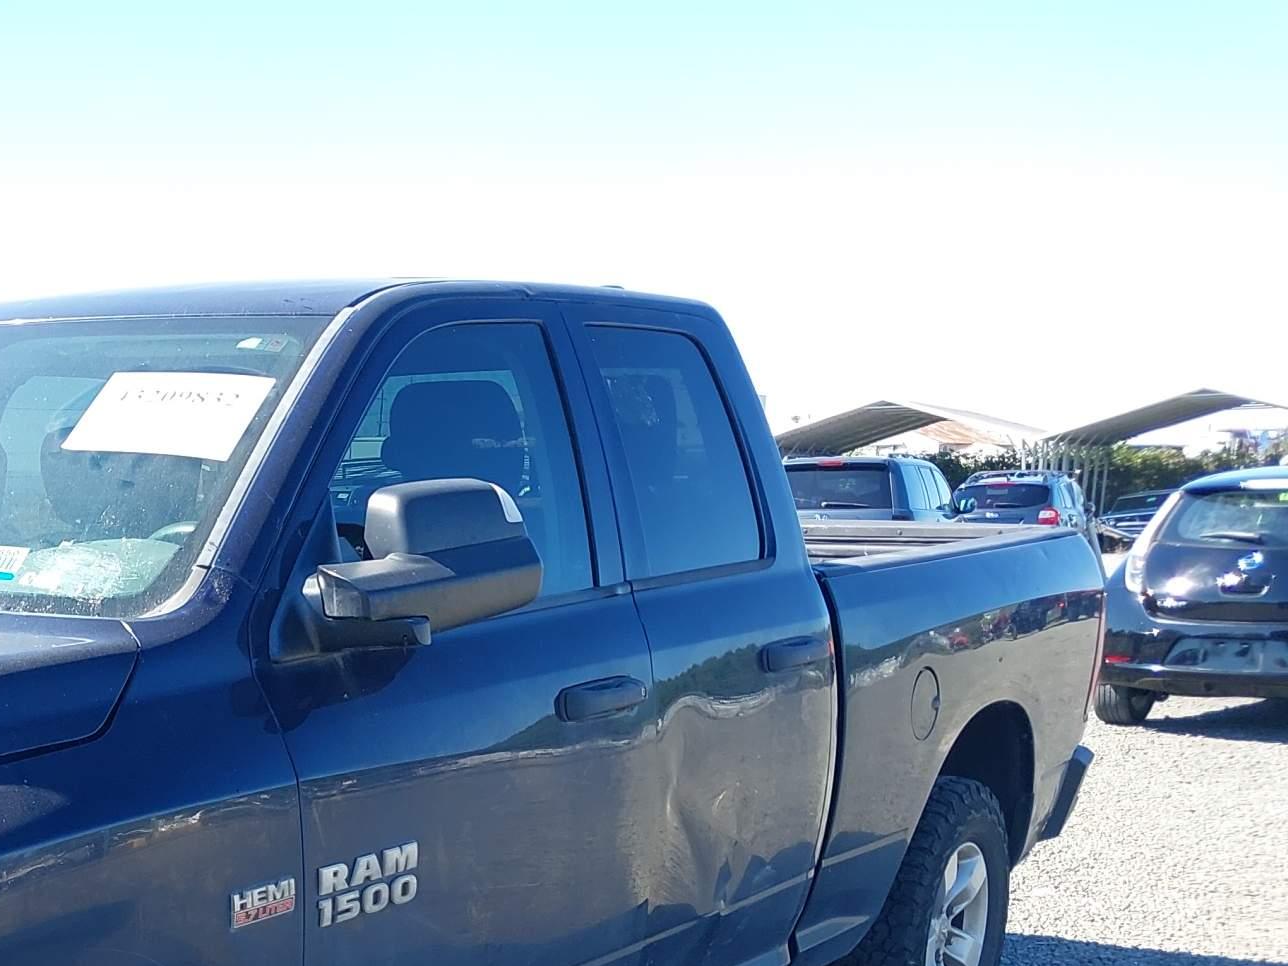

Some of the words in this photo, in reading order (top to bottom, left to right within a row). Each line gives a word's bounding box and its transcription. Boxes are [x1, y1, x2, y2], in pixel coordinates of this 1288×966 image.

[233, 878, 296, 912] HEMI
[319, 841, 419, 896] RAM
[318, 874, 418, 928] 1500
